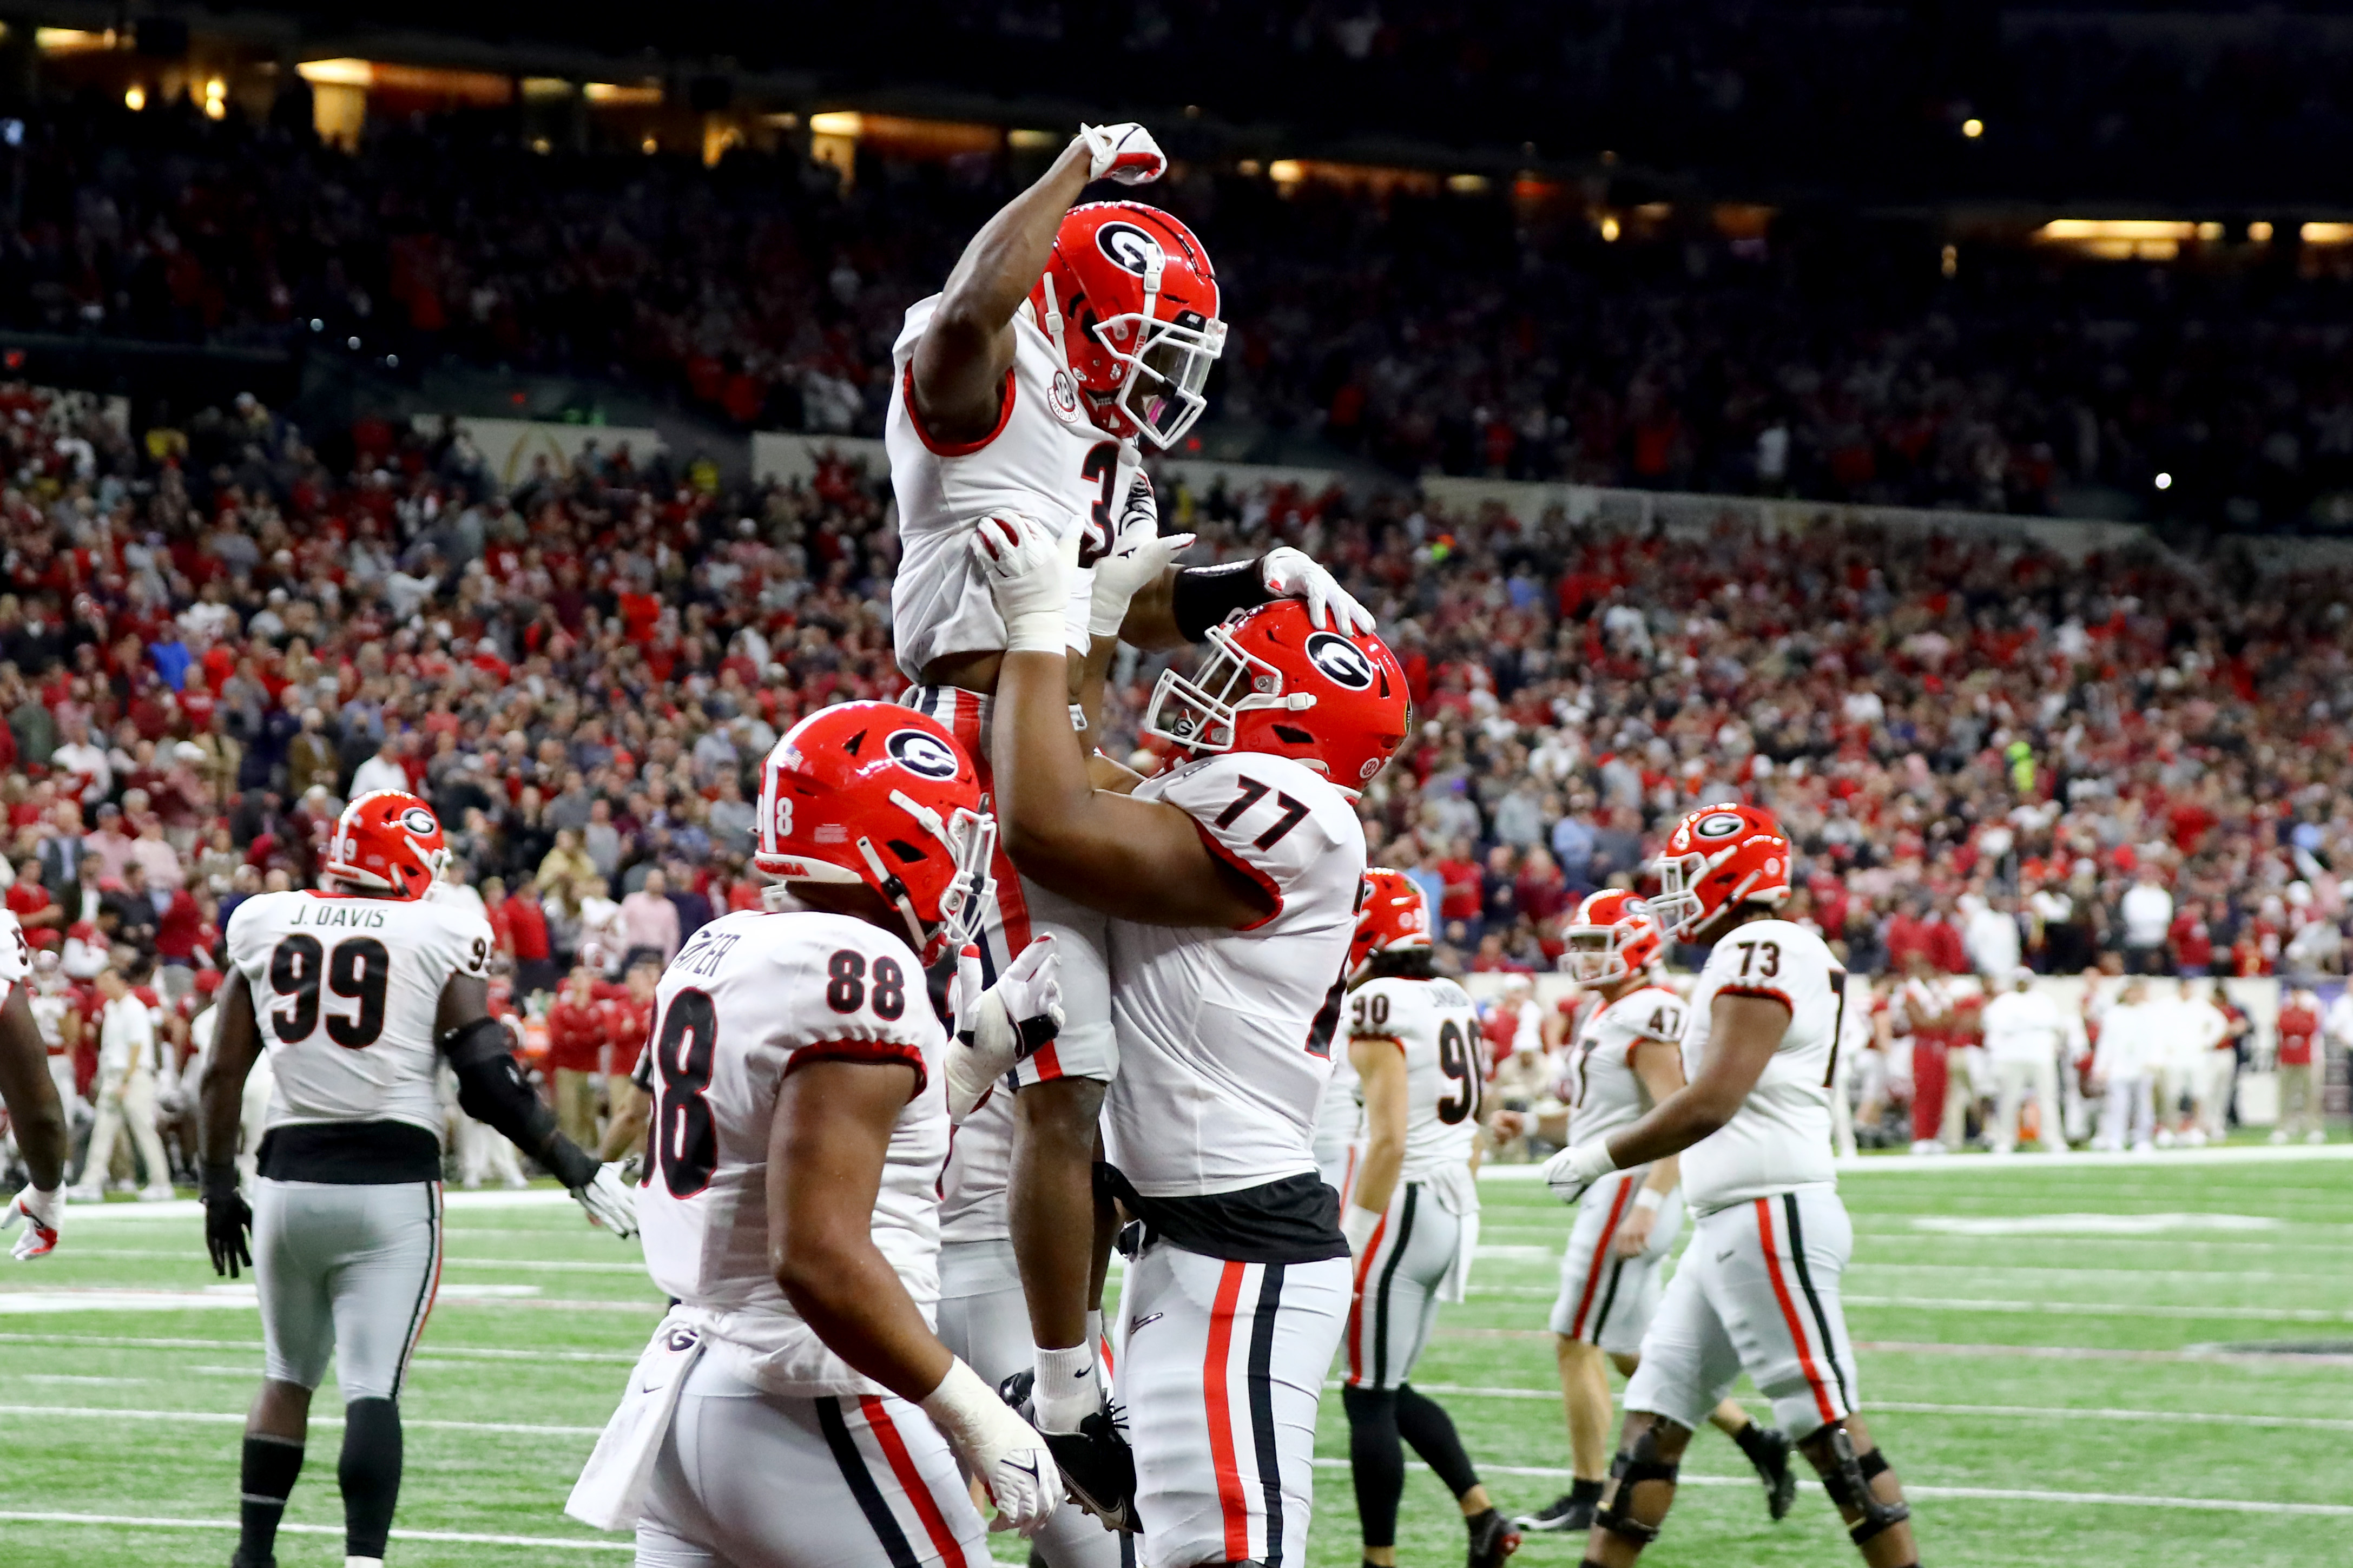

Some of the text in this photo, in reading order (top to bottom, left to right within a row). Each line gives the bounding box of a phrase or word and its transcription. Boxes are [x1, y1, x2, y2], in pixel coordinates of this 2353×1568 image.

[1050, 397, 1078, 421] GRADUATE
[1078, 440, 1121, 569] 3
[1214, 774, 1310, 851] 77
[289, 906, 388, 928] J. DAVIS
[469, 938, 492, 972] 9
[1738, 942, 1779, 978] 73
[271, 934, 389, 1050] 99
[826, 949, 905, 1020] 88
[1352, 993, 1389, 1026] 90
[1648, 1006, 1680, 1033] 47
[642, 986, 717, 1200] 8
